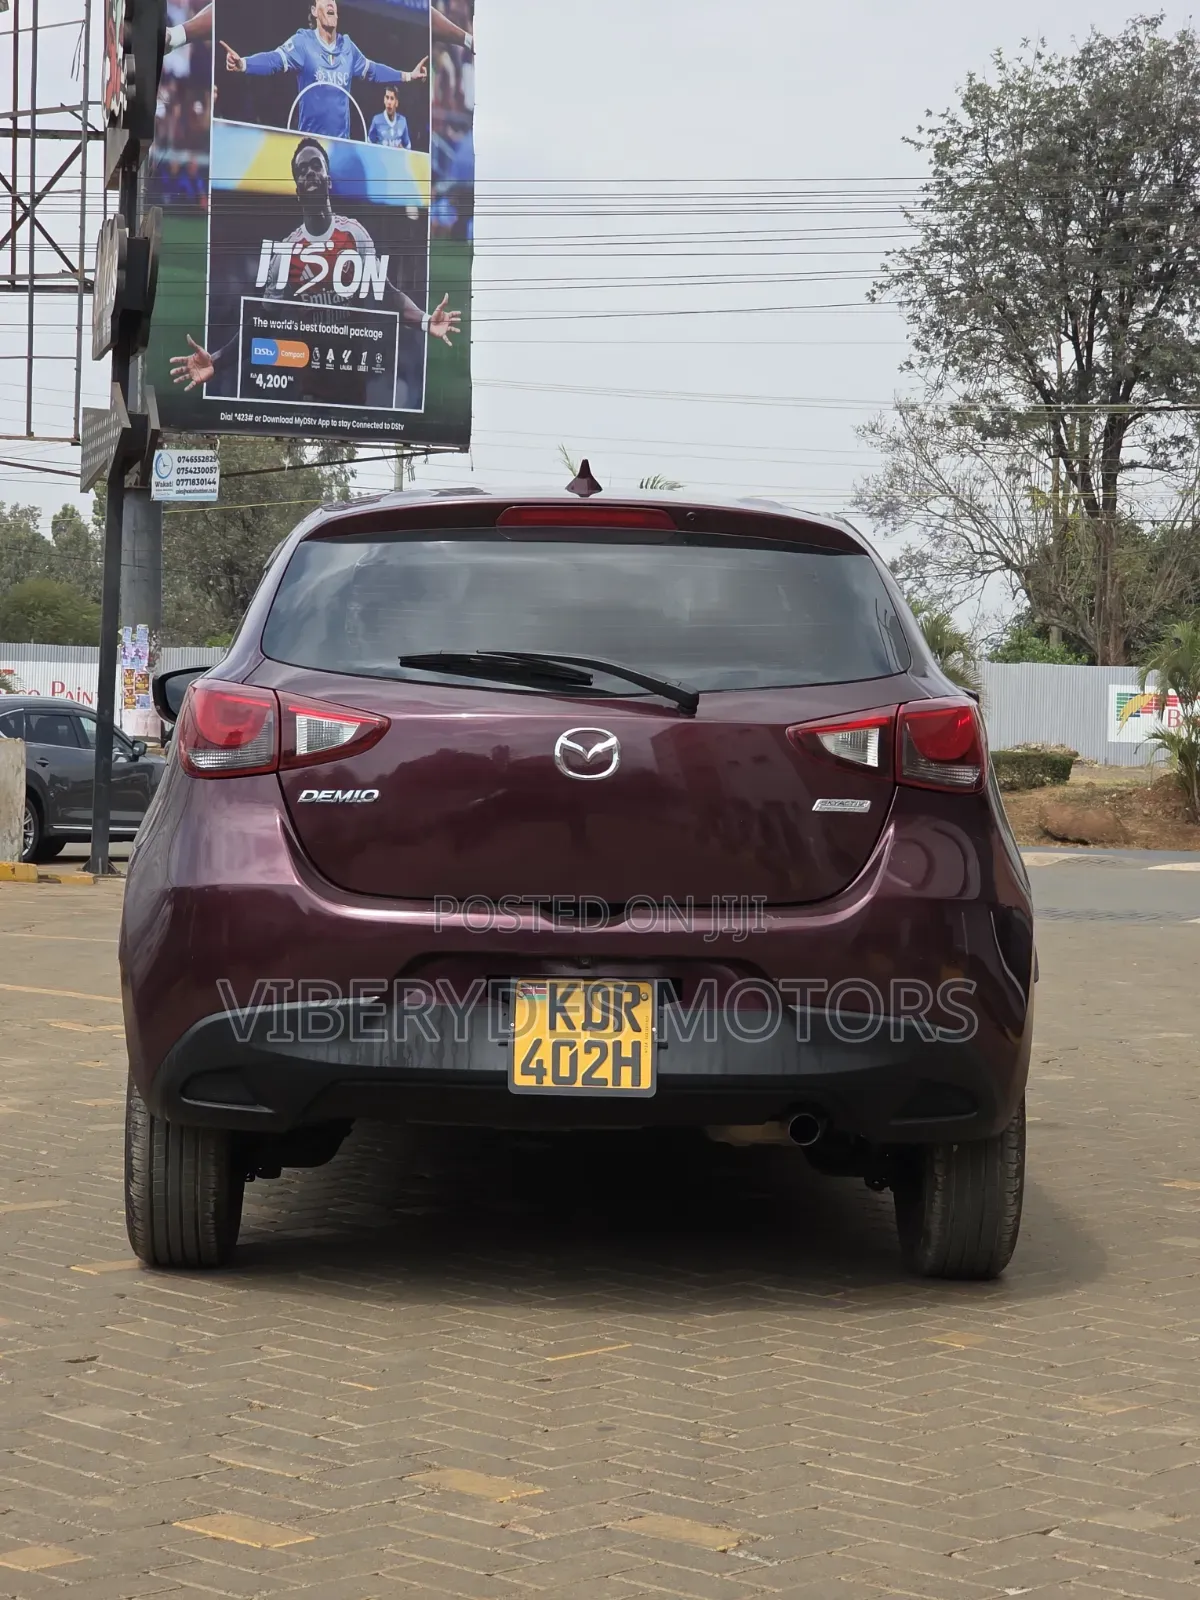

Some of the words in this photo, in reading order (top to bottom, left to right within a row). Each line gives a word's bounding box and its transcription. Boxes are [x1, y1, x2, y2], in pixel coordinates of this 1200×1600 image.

[327, 71, 350, 86] MSC
[332, 249, 389, 301] ON
[253, 317, 268, 328] The
[270, 319, 299, 331] world's
[300, 321, 317, 333] best
[318, 322, 348, 335] football
[350, 326, 383, 341] package
[254, 347, 276, 356] DStv
[281, 350, 305, 359] Compact
[255, 373, 288, 389] 4,200
[220, 412, 233, 421] Dial
[263, 415, 293, 424] Download
[294, 417, 317, 427] MyDStv
[318, 418, 330, 428] App
[331, 419, 338, 427] to
[338, 420, 351, 430] stay
[352, 420, 383, 430] Connected
[384, 422, 390, 430] to
[391, 422, 404, 431] DStv
[176, 466, 218, 475] 0754230057
[175, 478, 216, 486] 0771830144
[297, 789, 379, 803] DEMIO
[521, 1038, 641, 1087] 402H
